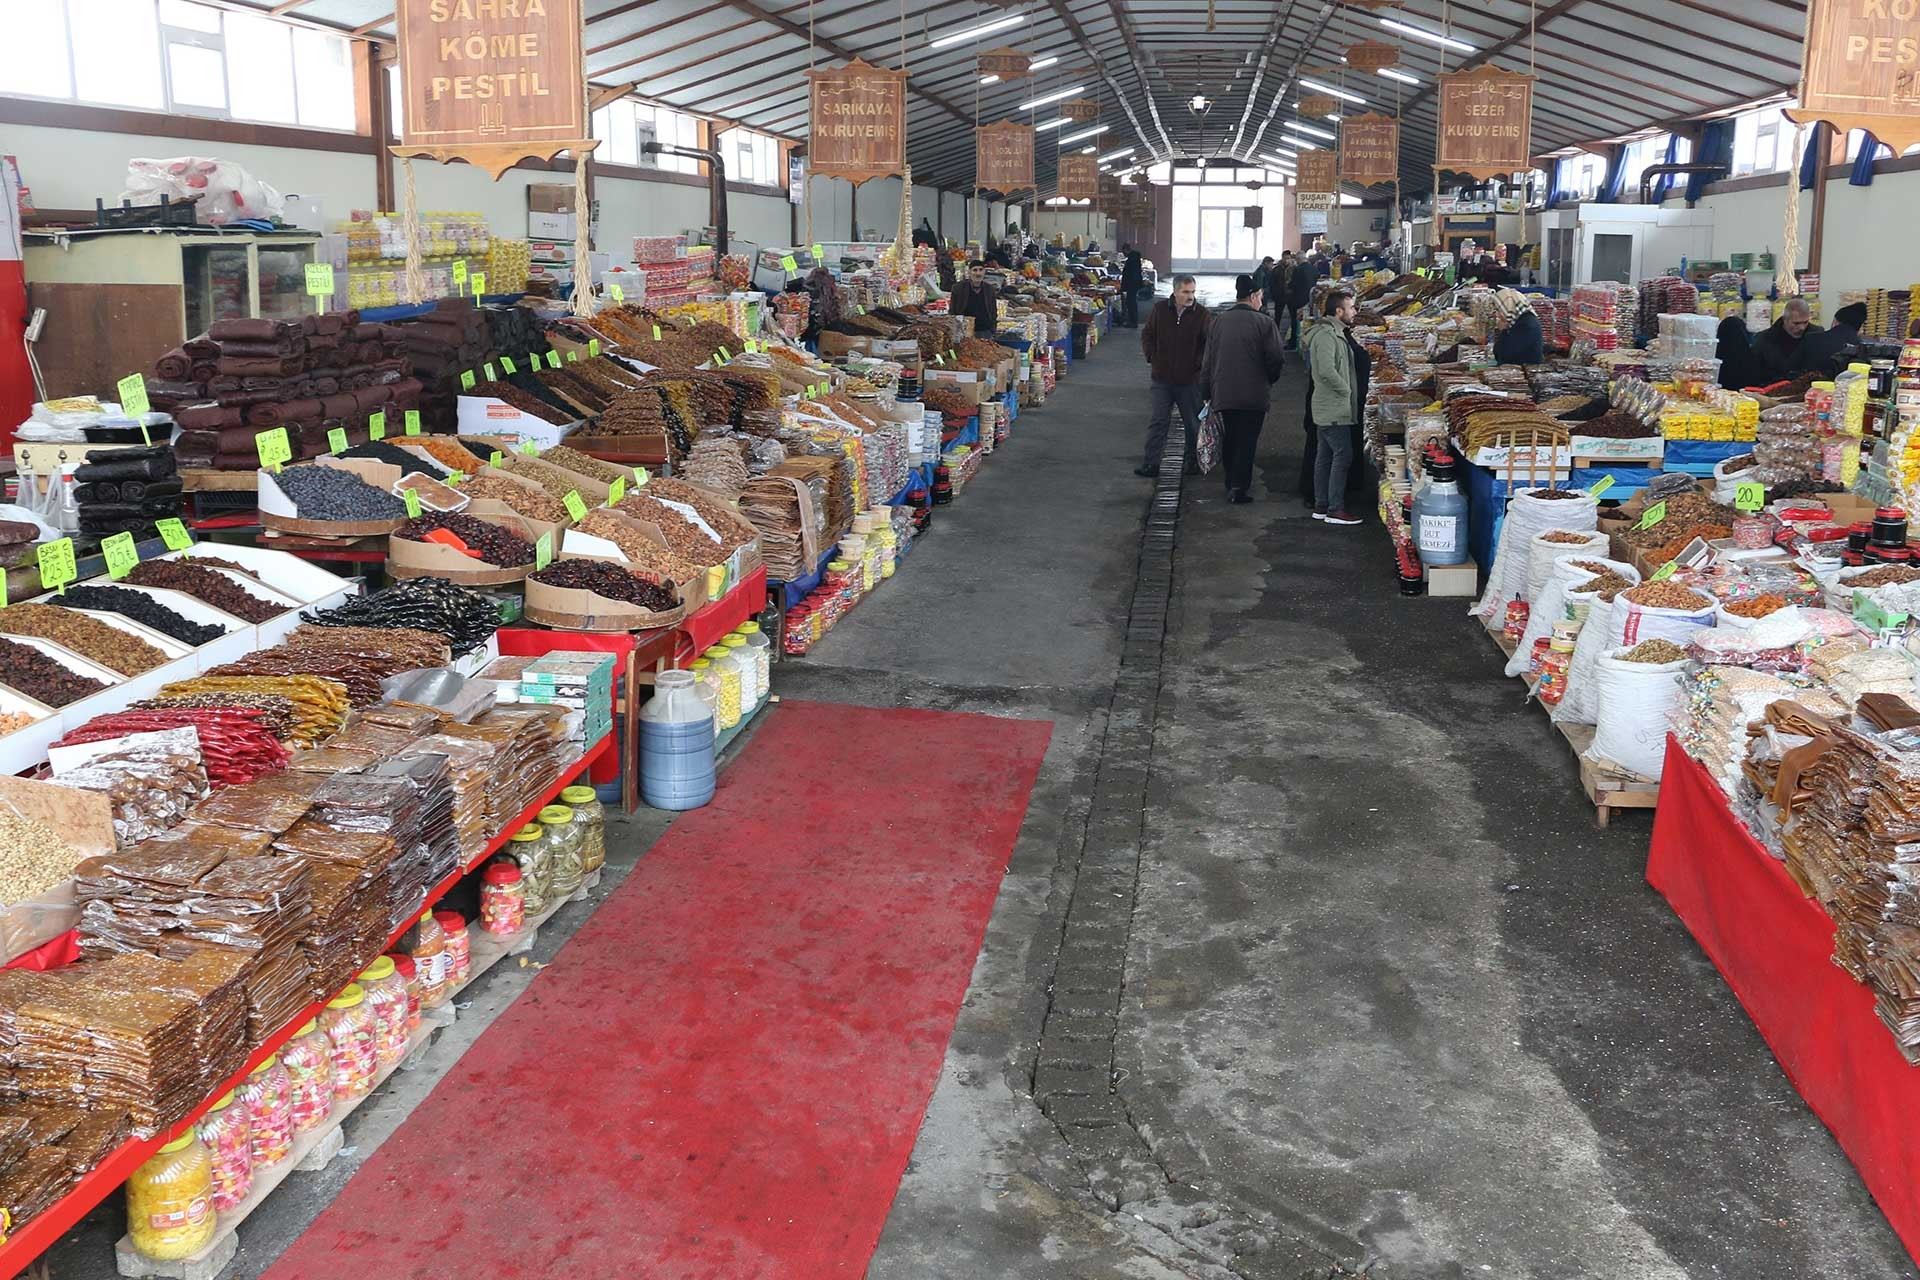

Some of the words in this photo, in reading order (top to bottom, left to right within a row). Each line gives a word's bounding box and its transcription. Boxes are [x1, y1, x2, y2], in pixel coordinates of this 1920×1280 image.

[430, 0, 546, 22] SAHRA
[440, 31, 538, 61] KÖME
[1846, 35, 1918, 63] PES
[432, 67, 550, 100] PESTİL
[823, 103, 893, 116] SARIKAYA
[1464, 104, 1505, 117] SEZER
[1737, 487, 1753, 503] 20
